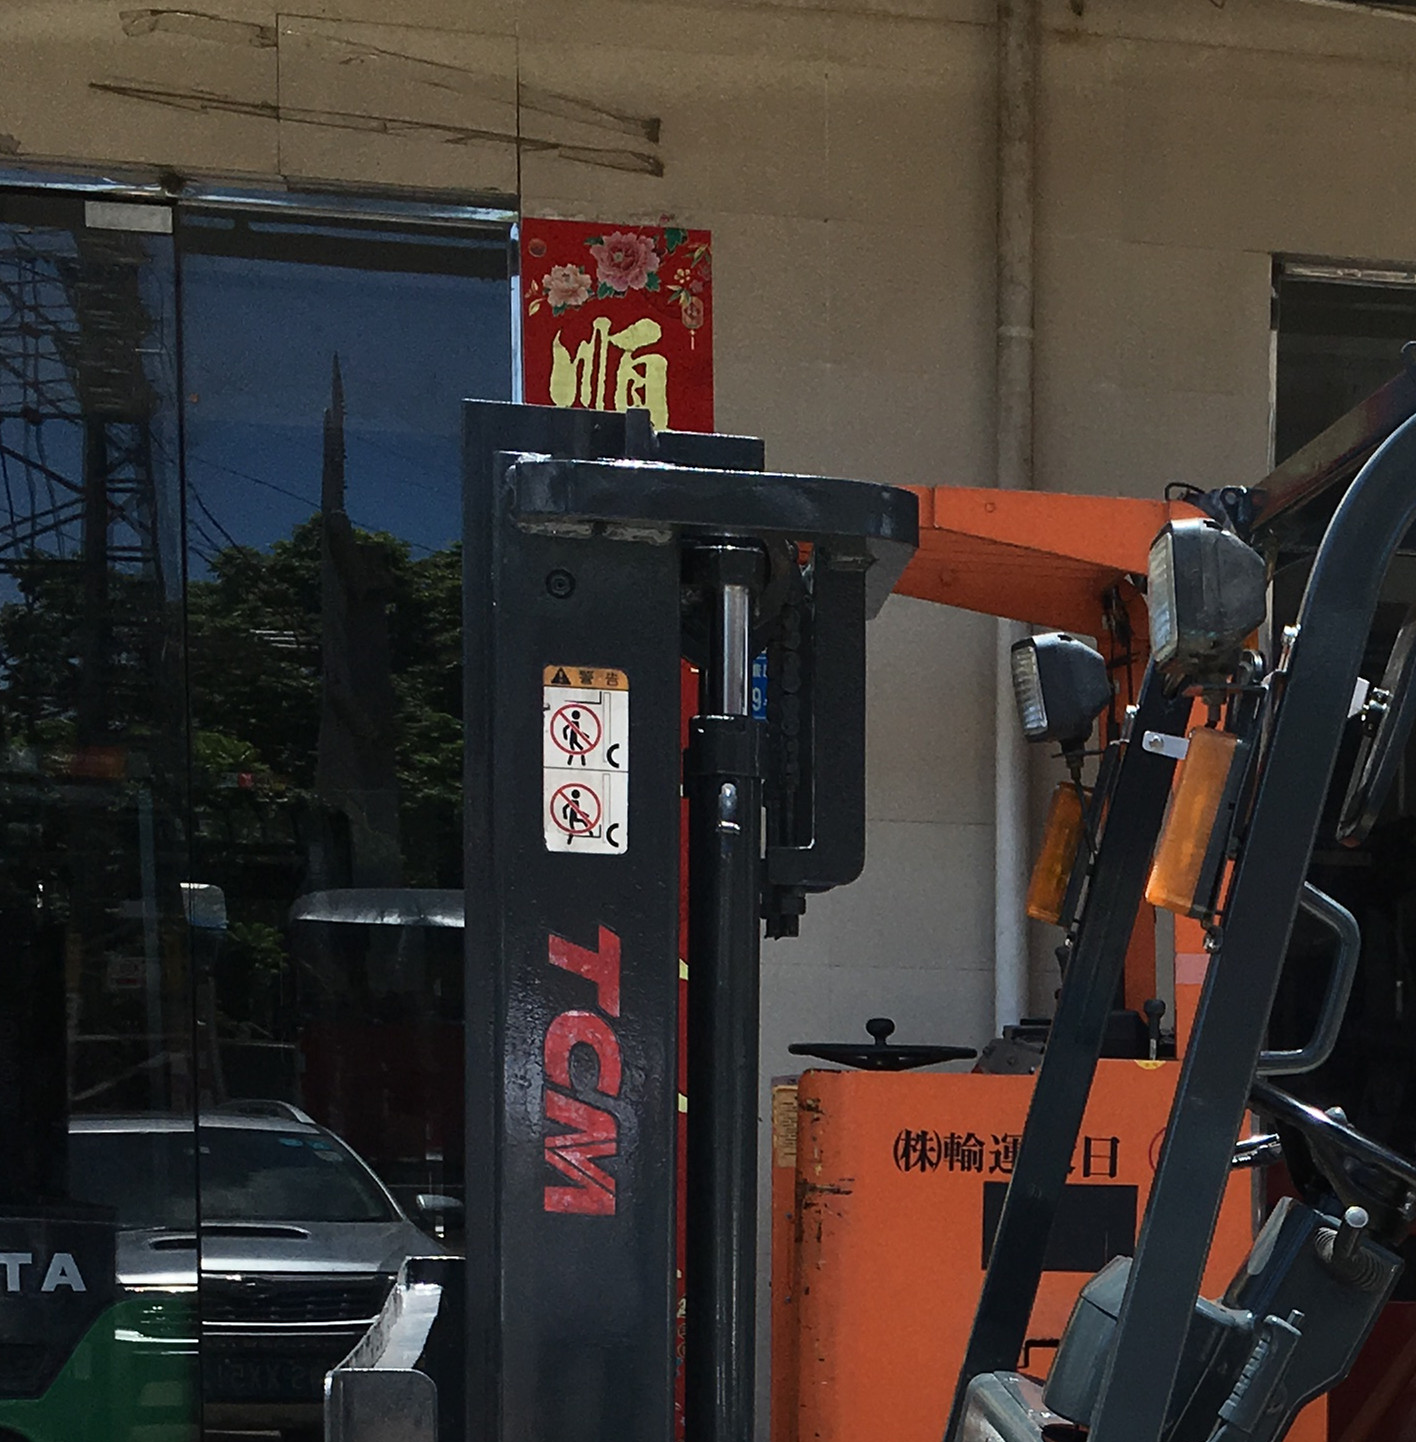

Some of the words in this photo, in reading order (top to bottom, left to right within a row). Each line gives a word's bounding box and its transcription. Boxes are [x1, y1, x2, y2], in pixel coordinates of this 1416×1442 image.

[578, 669, 619, 687] 警告
[543, 924, 625, 1217] TCM
[0, 1252, 87, 1292] TA
